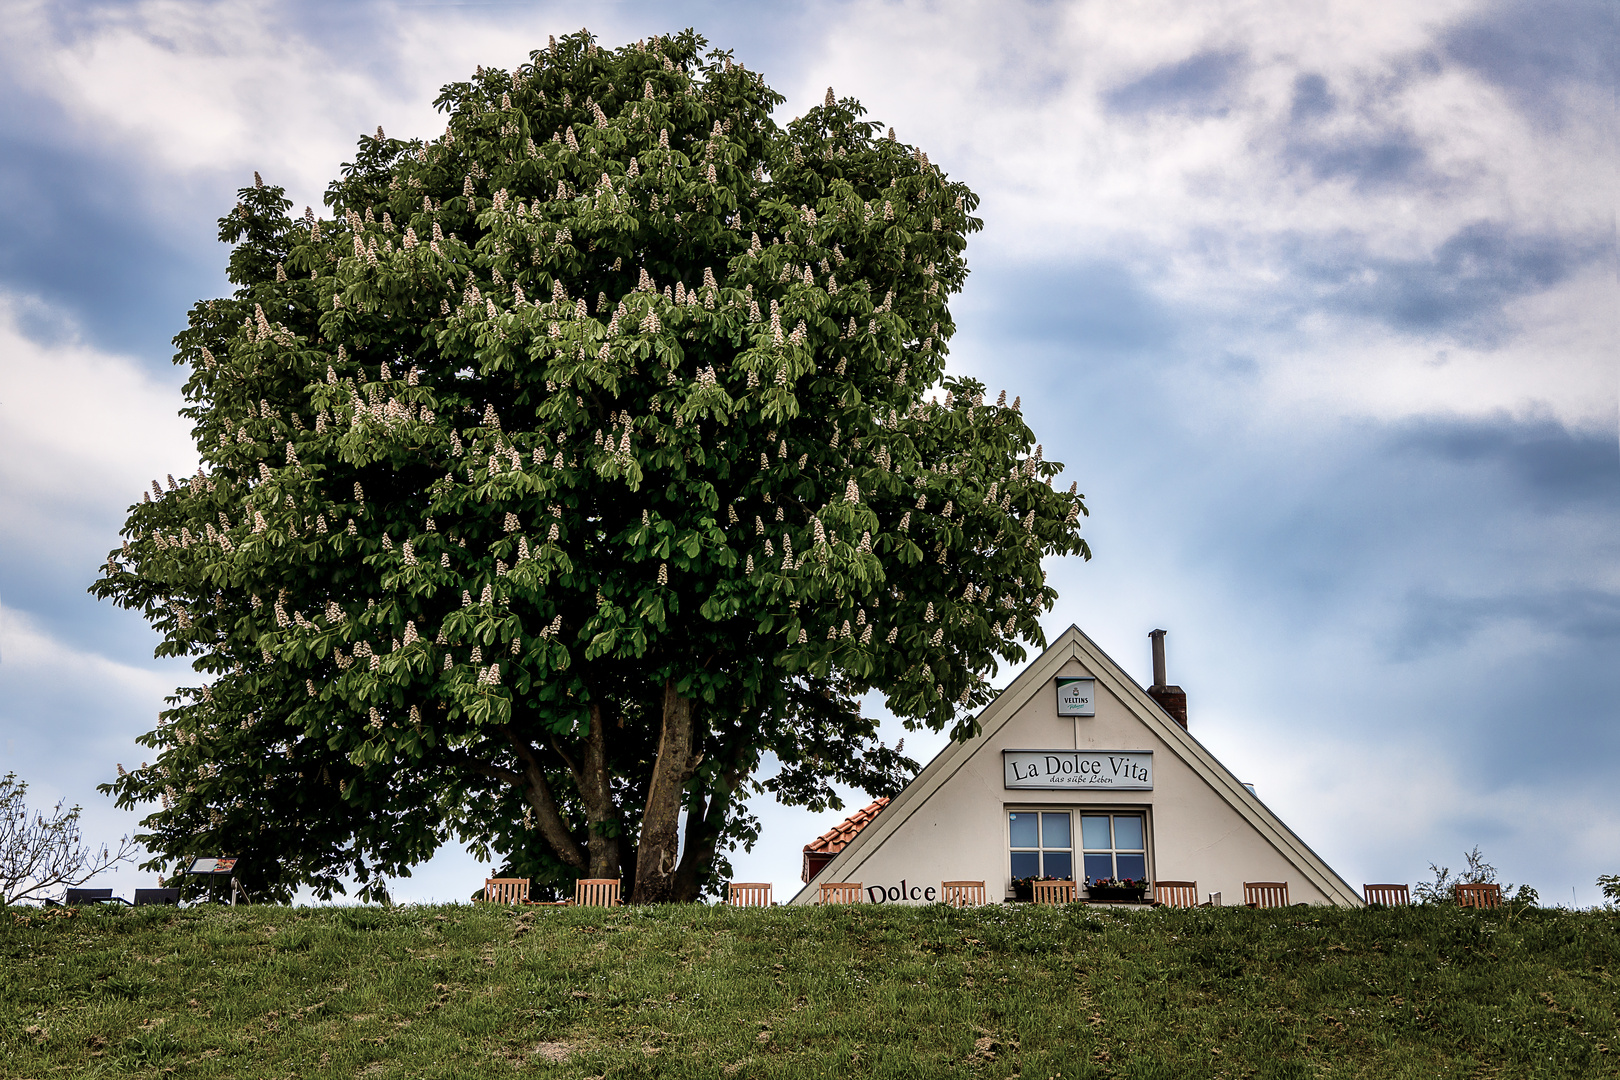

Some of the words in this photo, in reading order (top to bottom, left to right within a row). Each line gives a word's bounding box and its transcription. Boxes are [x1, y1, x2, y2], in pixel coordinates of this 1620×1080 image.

[1011, 761, 1039, 781] La
[1044, 754, 1101, 775] Dolce
[1108, 756, 1148, 782] Vita
[1049, 775, 1065, 783] das
[1066, 774, 1087, 784] süße
[1088, 775, 1113, 784] Leben
[864, 879, 936, 905] Dolce
